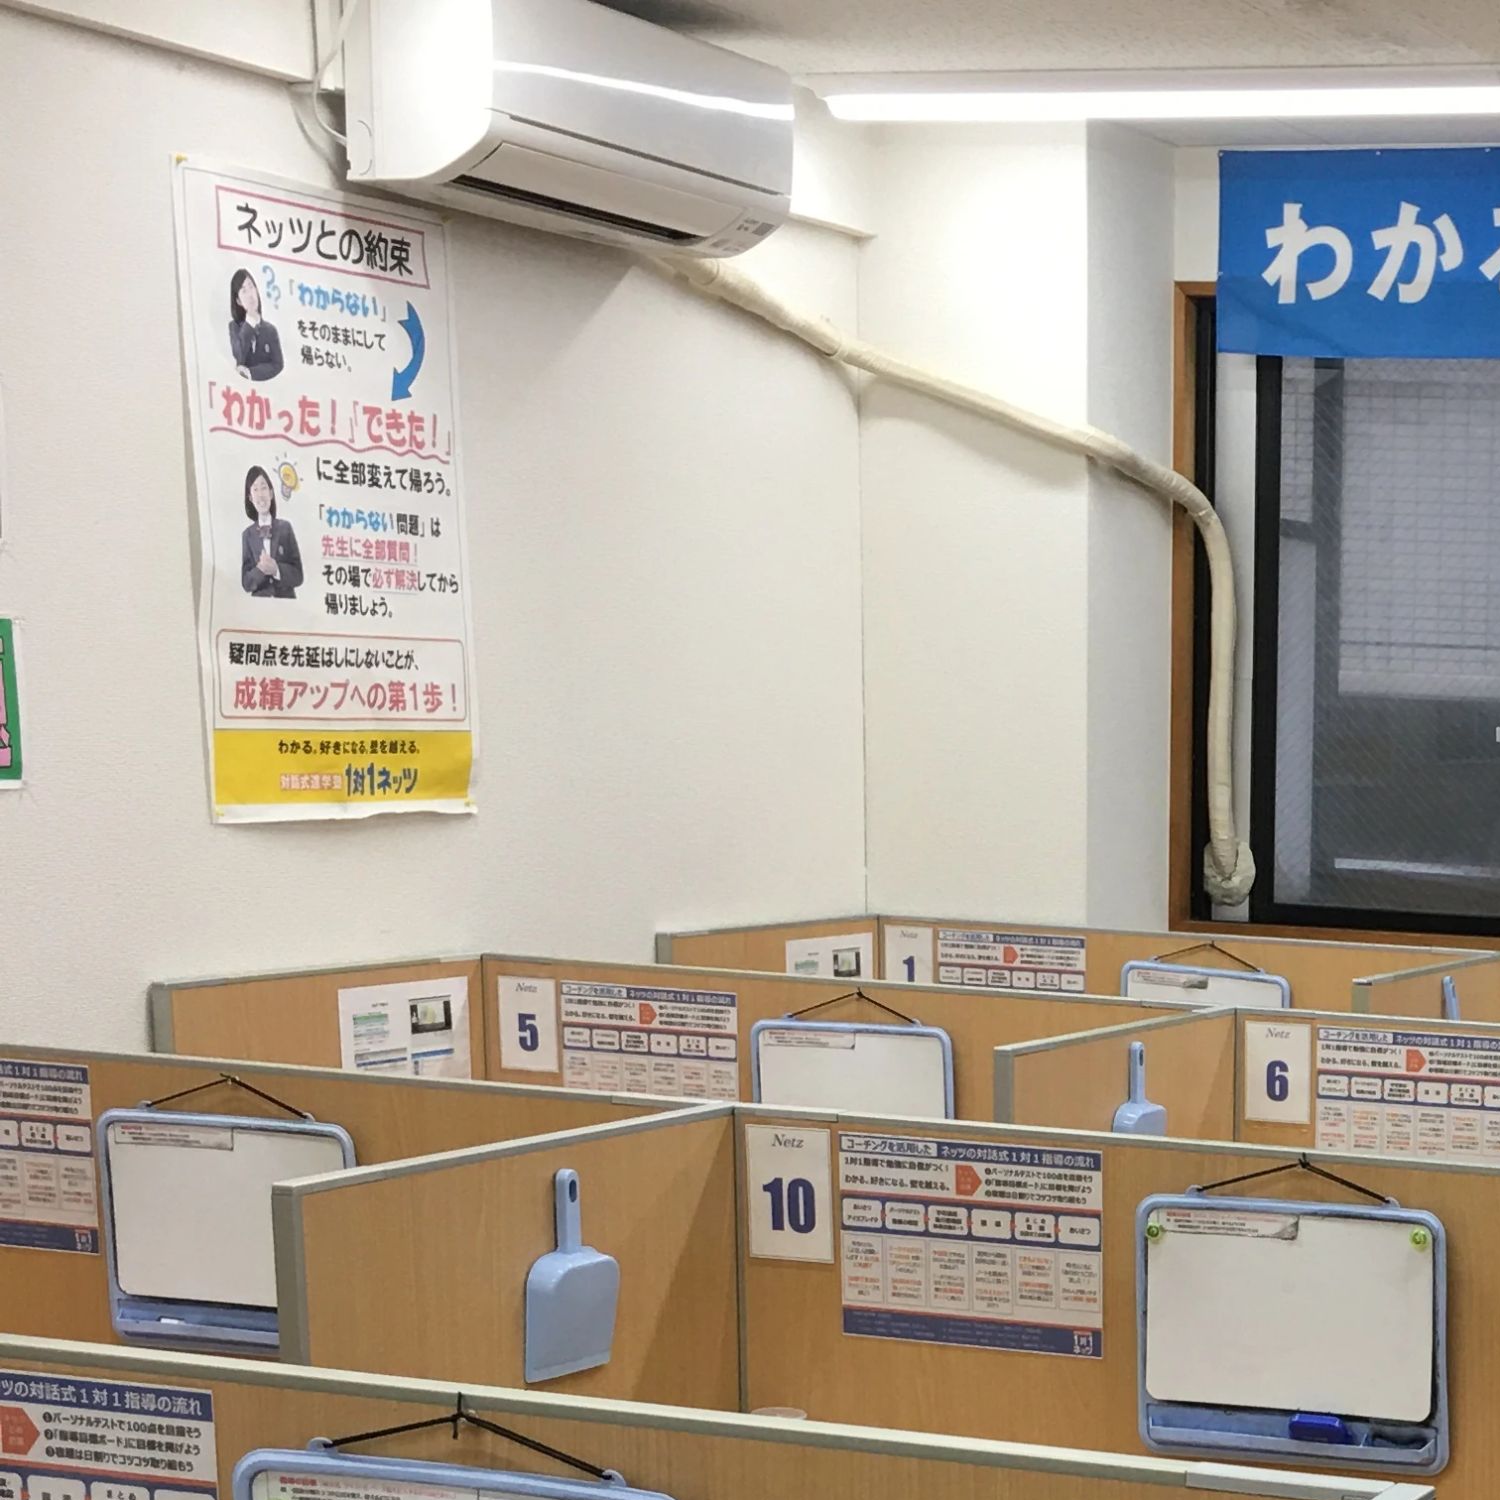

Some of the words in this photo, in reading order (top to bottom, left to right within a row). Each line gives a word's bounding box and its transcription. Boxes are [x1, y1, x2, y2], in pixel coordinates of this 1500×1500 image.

[236, 203, 413, 276] ネッツとの約束
[289, 279, 386, 321] 「わからない」
[297, 320, 386, 351] をそのままにして
[301, 345, 351, 372] 帰らない。
[316, 457, 451, 496] に全部変えて帰ろう。
[325, 595, 393, 618] 帰りましょう。
[234, 677, 457, 713] 成績アップへの第1歩！
[518, 1013, 540, 1051] 5
[1266, 1060, 1289, 1102] 6
[771, 1133, 804, 1149] Netz
[762, 1177, 816, 1234] 10
